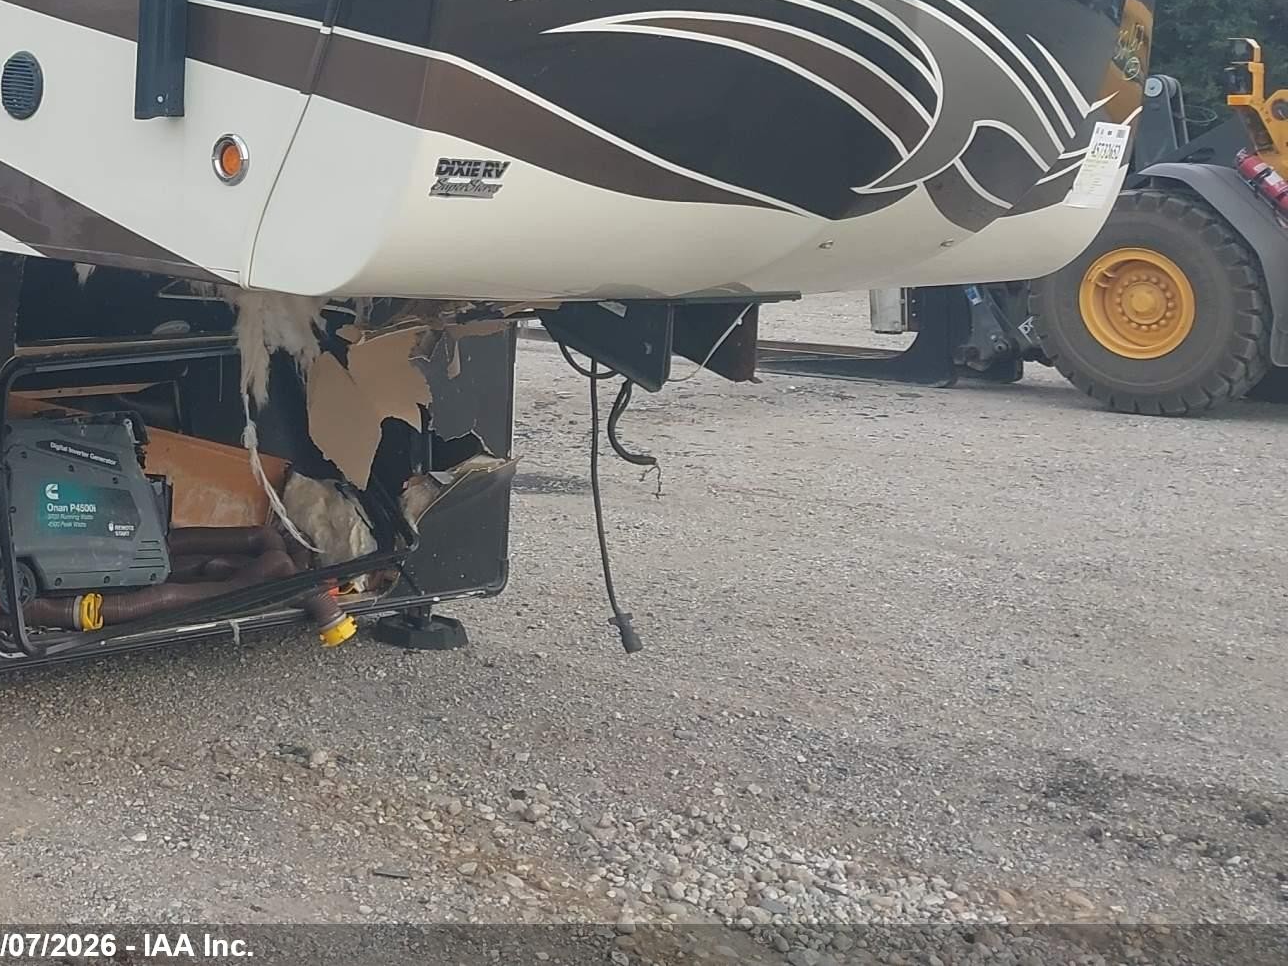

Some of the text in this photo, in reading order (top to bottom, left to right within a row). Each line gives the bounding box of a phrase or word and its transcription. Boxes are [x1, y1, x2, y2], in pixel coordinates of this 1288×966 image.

[435, 158, 511, 178] DIXIE RV
[50, 441, 117, 465] Digital Inverter Generator
[46, 502, 97, 513] Onan P4500i
